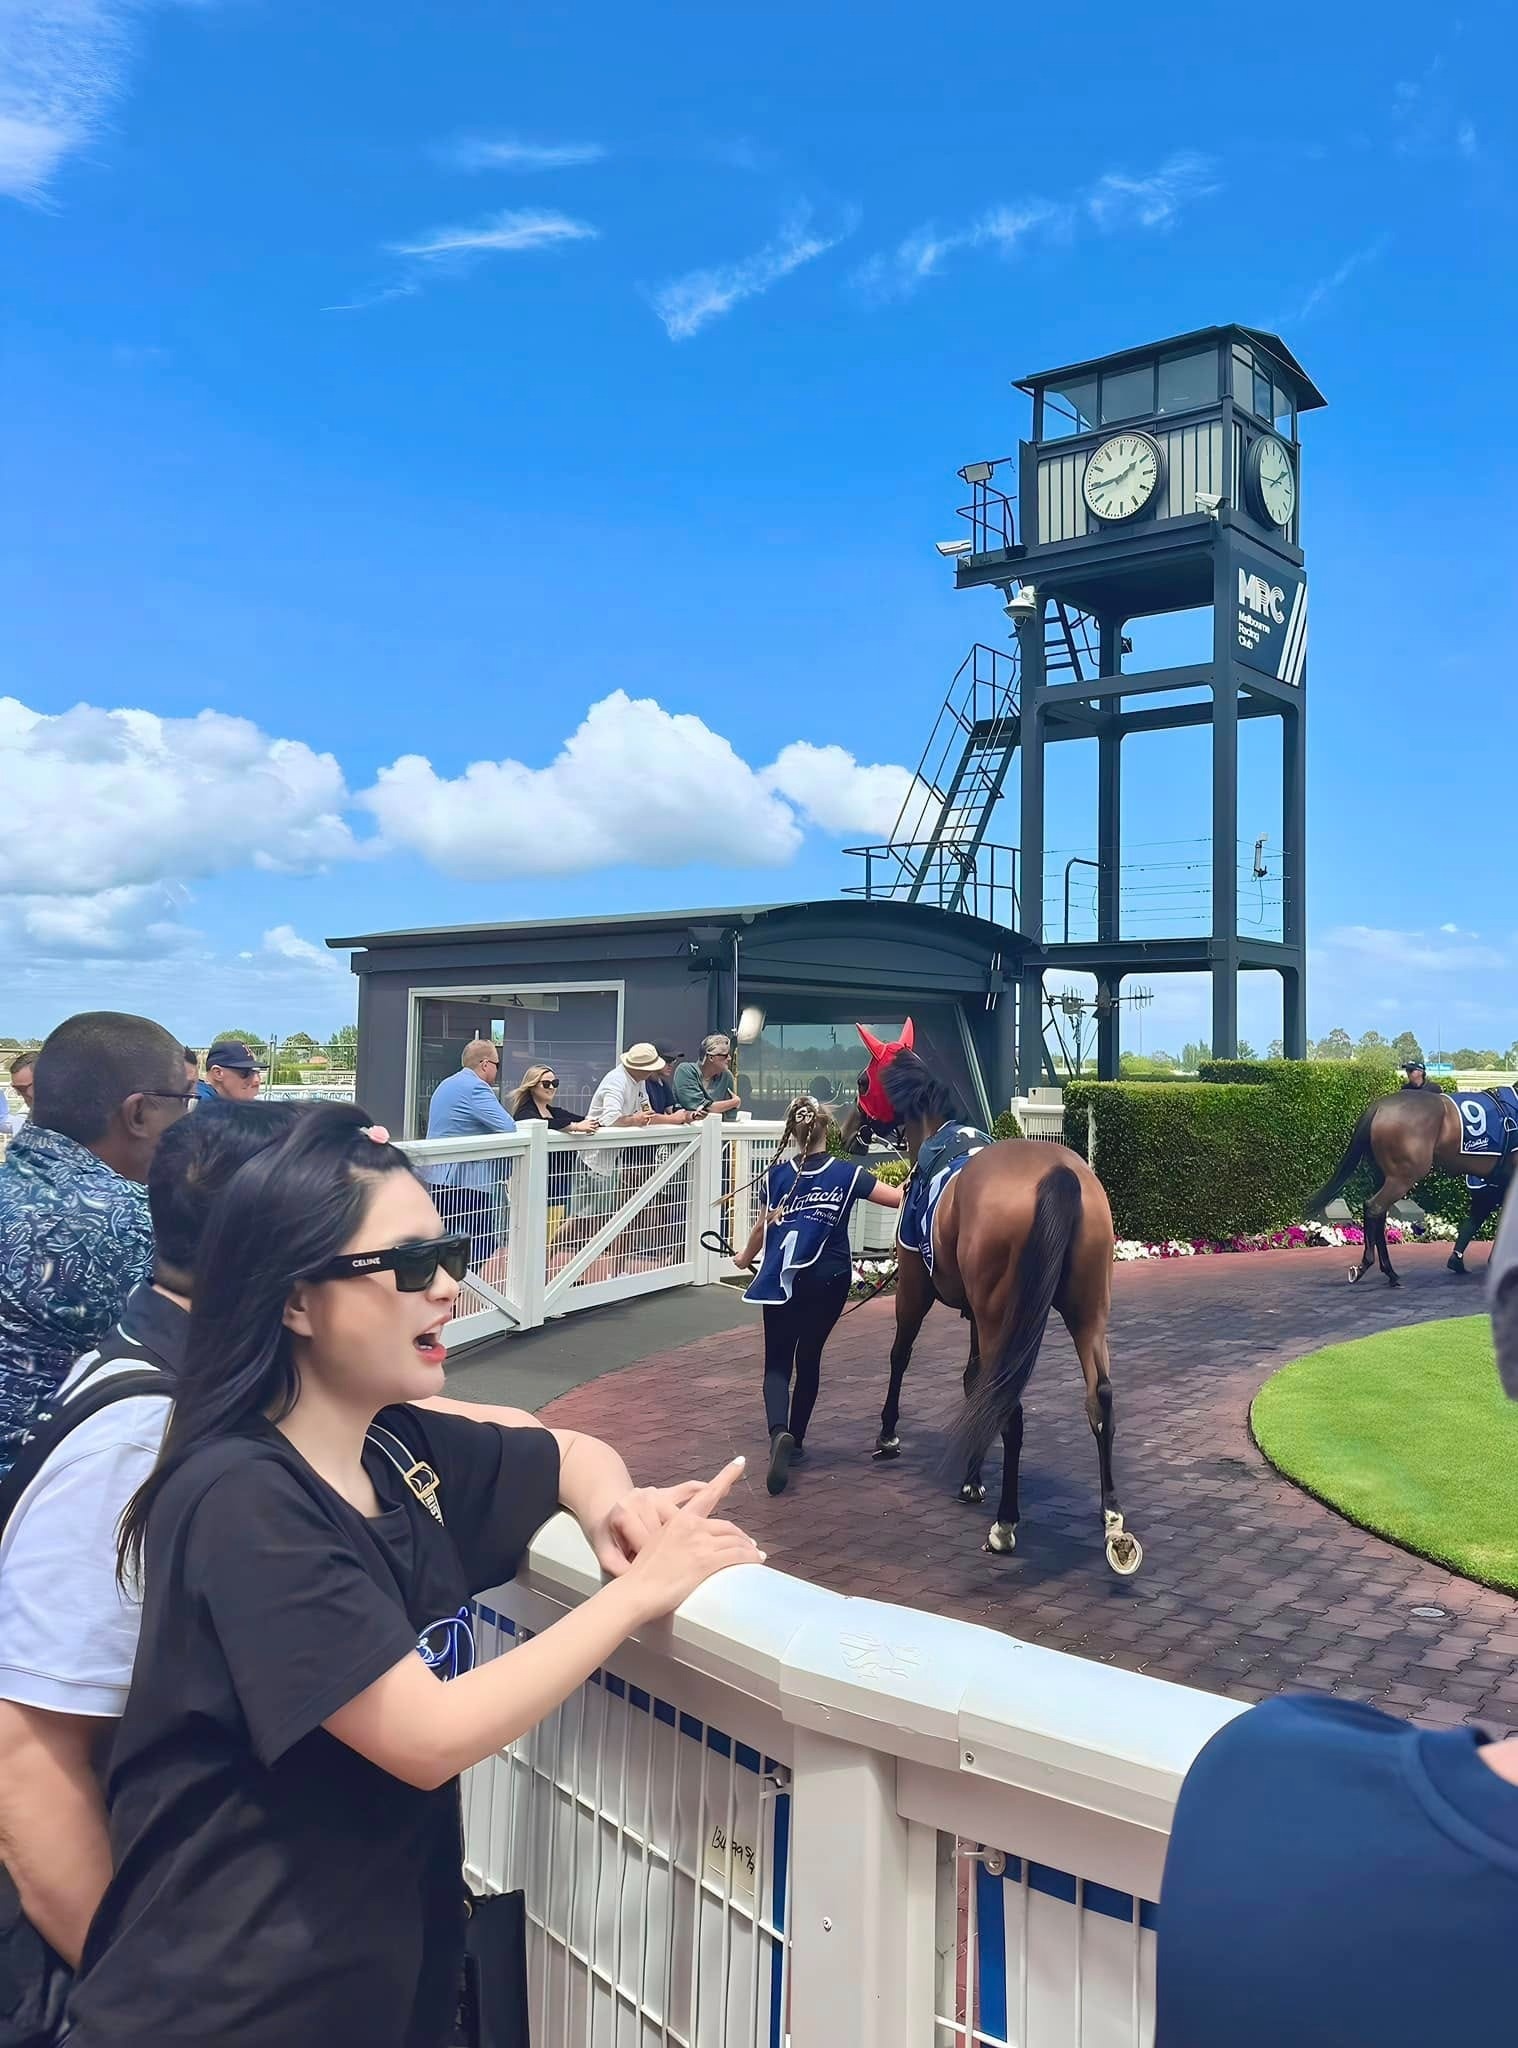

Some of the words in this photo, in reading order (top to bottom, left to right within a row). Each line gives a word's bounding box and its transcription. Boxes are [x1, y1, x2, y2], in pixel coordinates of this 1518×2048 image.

[1238, 567, 1285, 624] MRC
[1238, 622, 1259, 643] Racing
[1238, 634, 1254, 650] Club
[1460, 1099, 1487, 1137] 9
[352, 1256, 381, 1268] CELINE
[779, 1230, 799, 1287] 1
